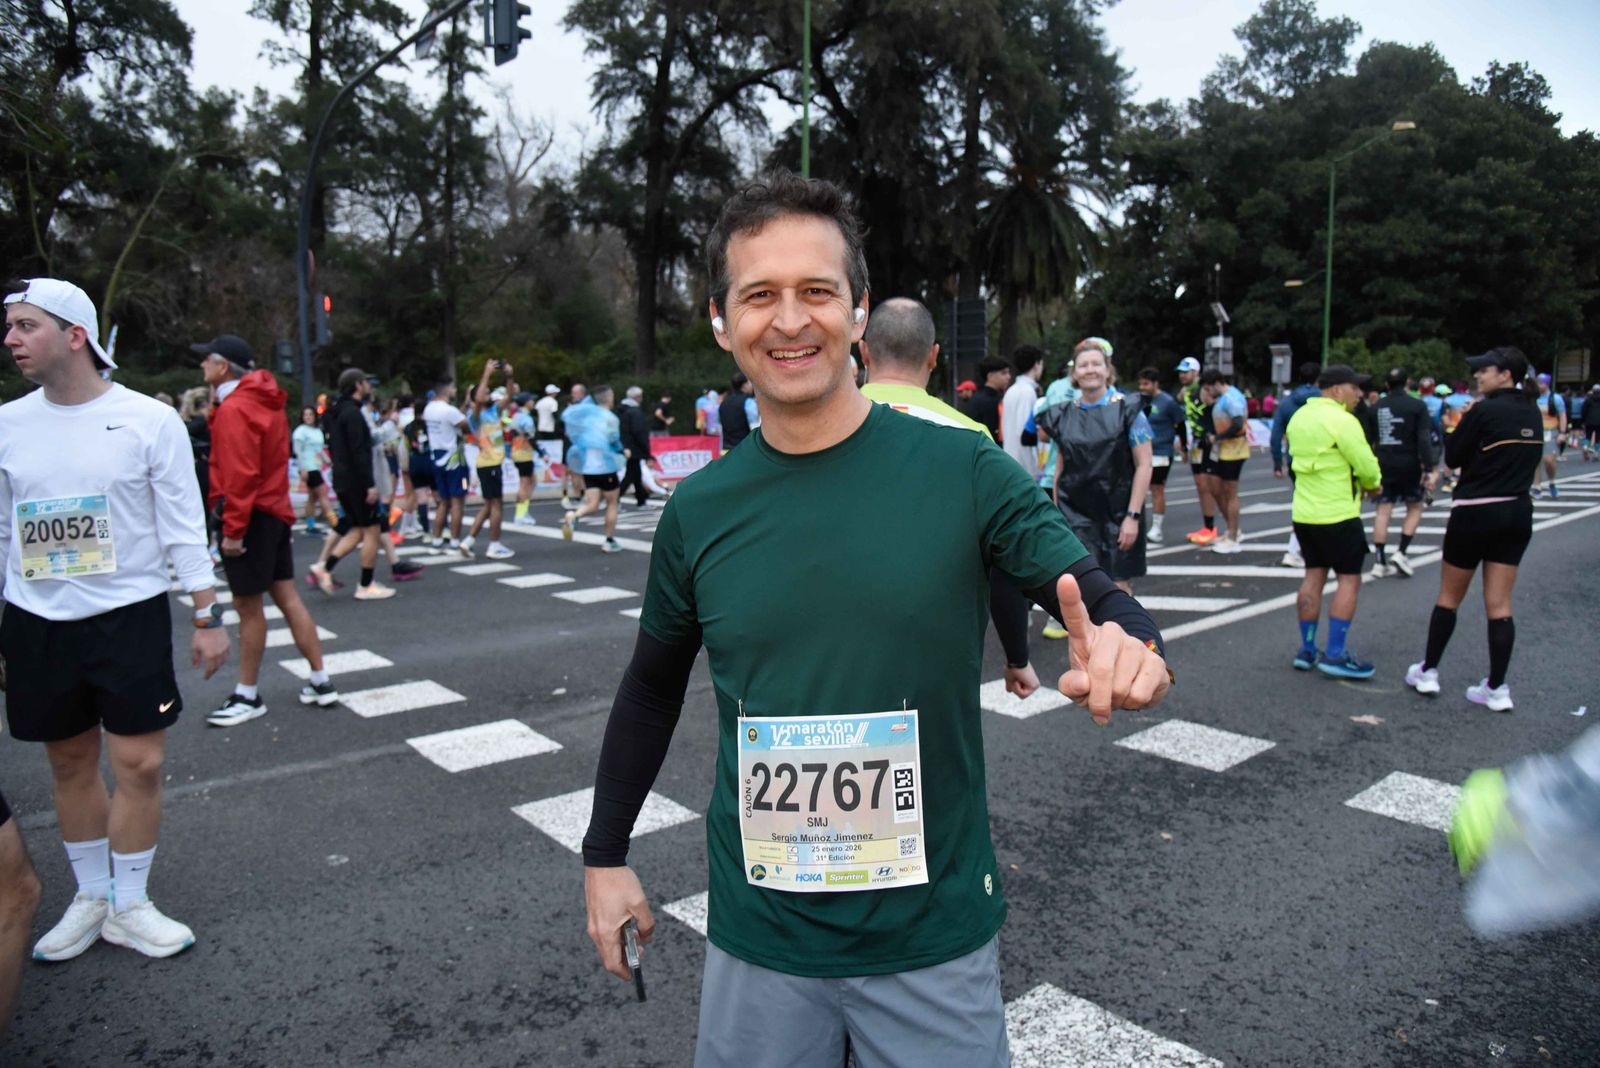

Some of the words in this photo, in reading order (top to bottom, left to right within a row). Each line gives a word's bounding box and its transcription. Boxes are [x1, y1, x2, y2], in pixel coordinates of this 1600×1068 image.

[24, 516, 96, 544] 20052
[790, 721, 854, 735] maratón
[804, 732, 854, 746] sevilla
[751, 760, 890, 812] 22767
[744, 787, 753, 818] CAJÓN
[807, 817, 828, 827] SMJ
[771, 833, 798, 843] Sergio
[800, 833, 831, 842] Muñoz
[834, 833, 874, 841] Jimenez
[844, 844, 862, 852] 2026
[795, 873, 823, 882] HOKA
[829, 873, 865, 883] Sprinter
